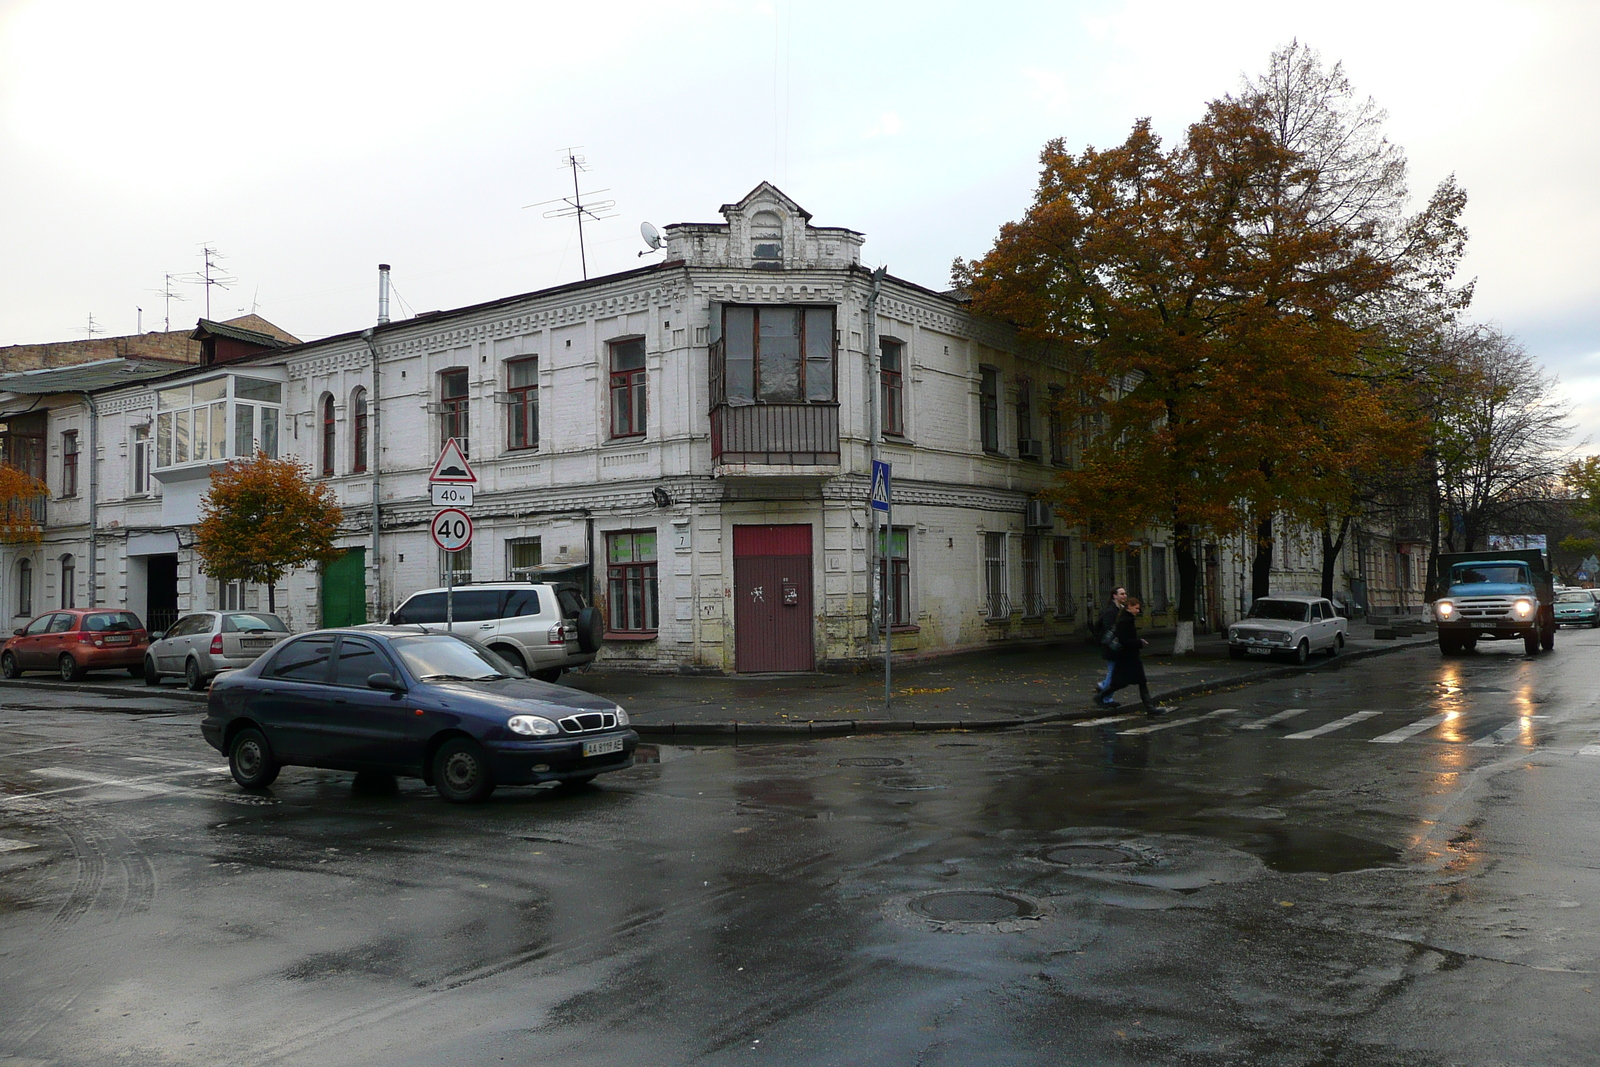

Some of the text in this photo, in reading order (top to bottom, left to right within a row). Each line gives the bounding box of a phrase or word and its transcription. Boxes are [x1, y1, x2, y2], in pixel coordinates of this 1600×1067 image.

[441, 490, 457, 501] 40
[437, 520, 465, 539] 40
[680, 536, 684, 545] 7
[588, 743, 597, 754] AA
[613, 739, 621, 750] AE
